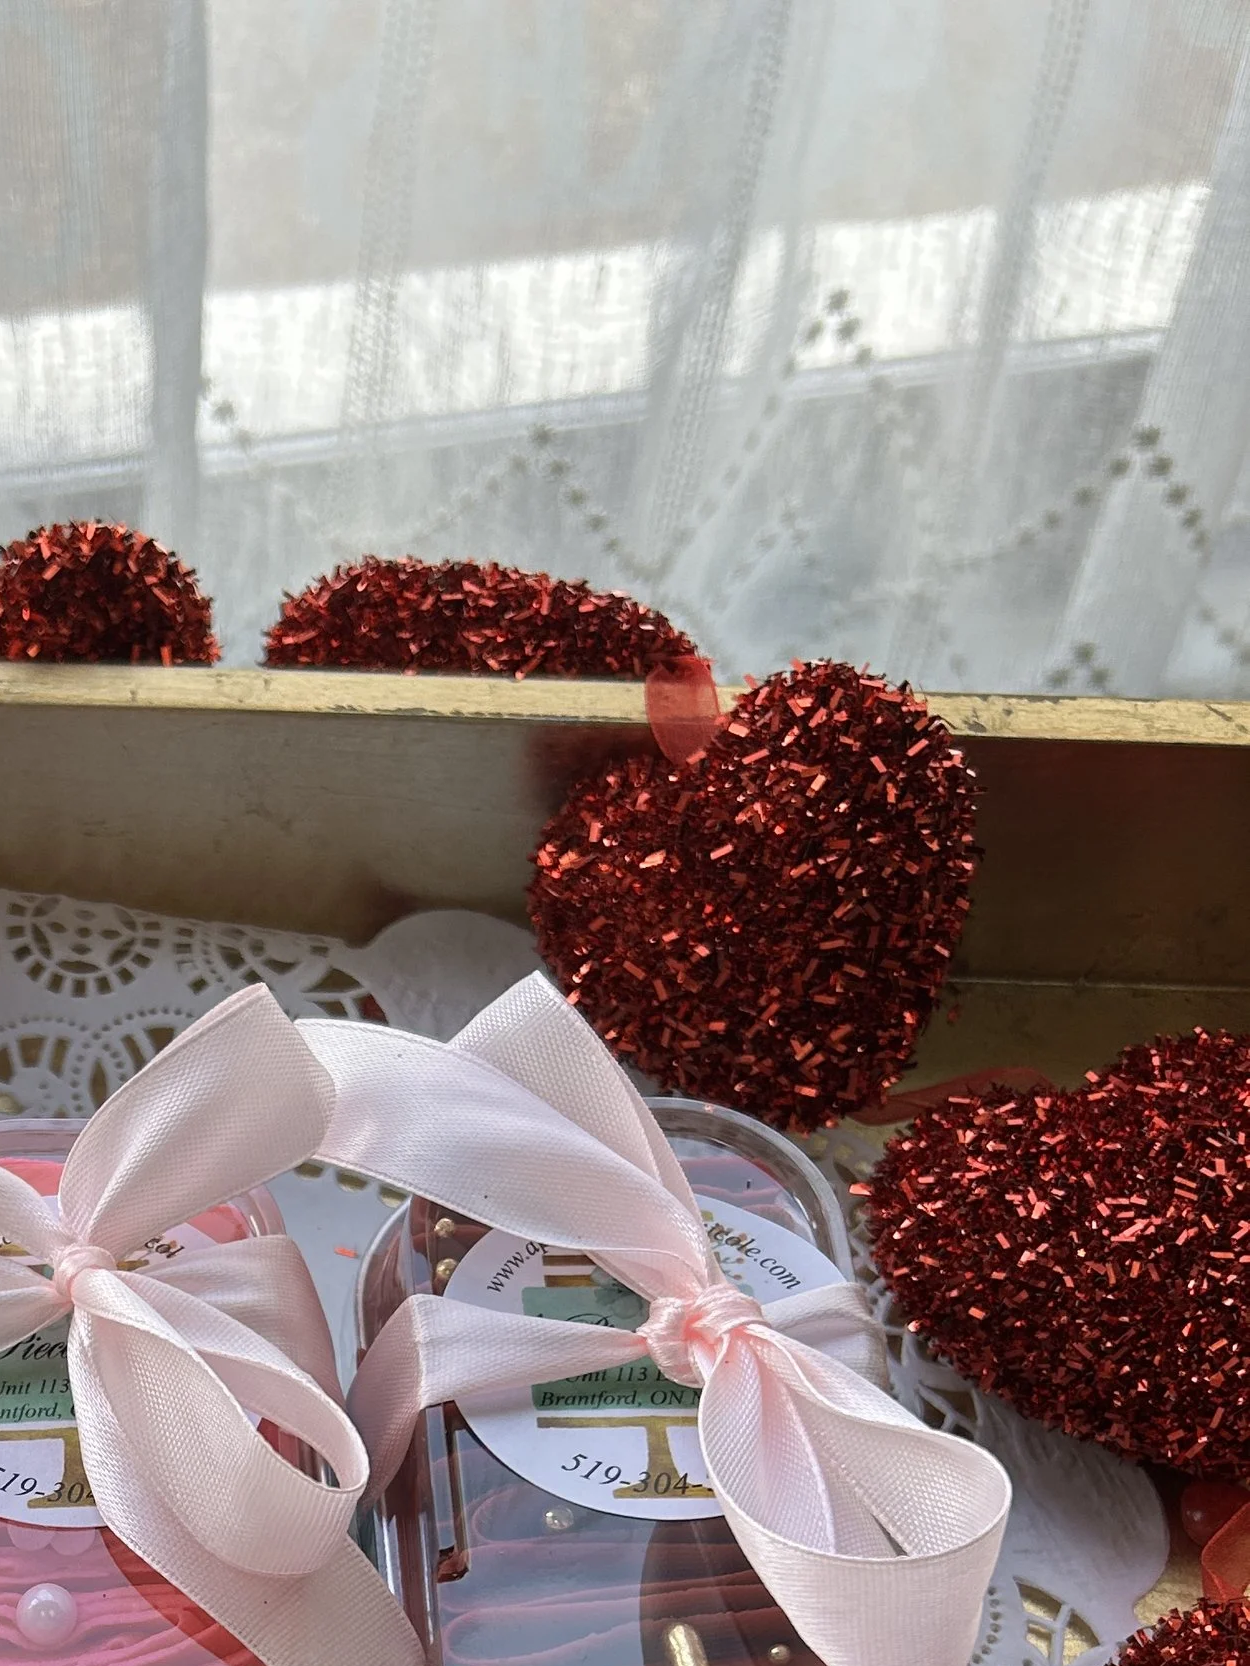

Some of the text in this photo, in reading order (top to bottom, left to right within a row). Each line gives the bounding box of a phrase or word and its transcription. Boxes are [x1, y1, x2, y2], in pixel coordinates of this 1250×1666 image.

[616, 1366, 648, 1382] 113
[540, 1390, 644, 1409] Brantford,
[650, 1390, 684, 1406] ON
[561, 1453, 713, 1495] 519-304-
